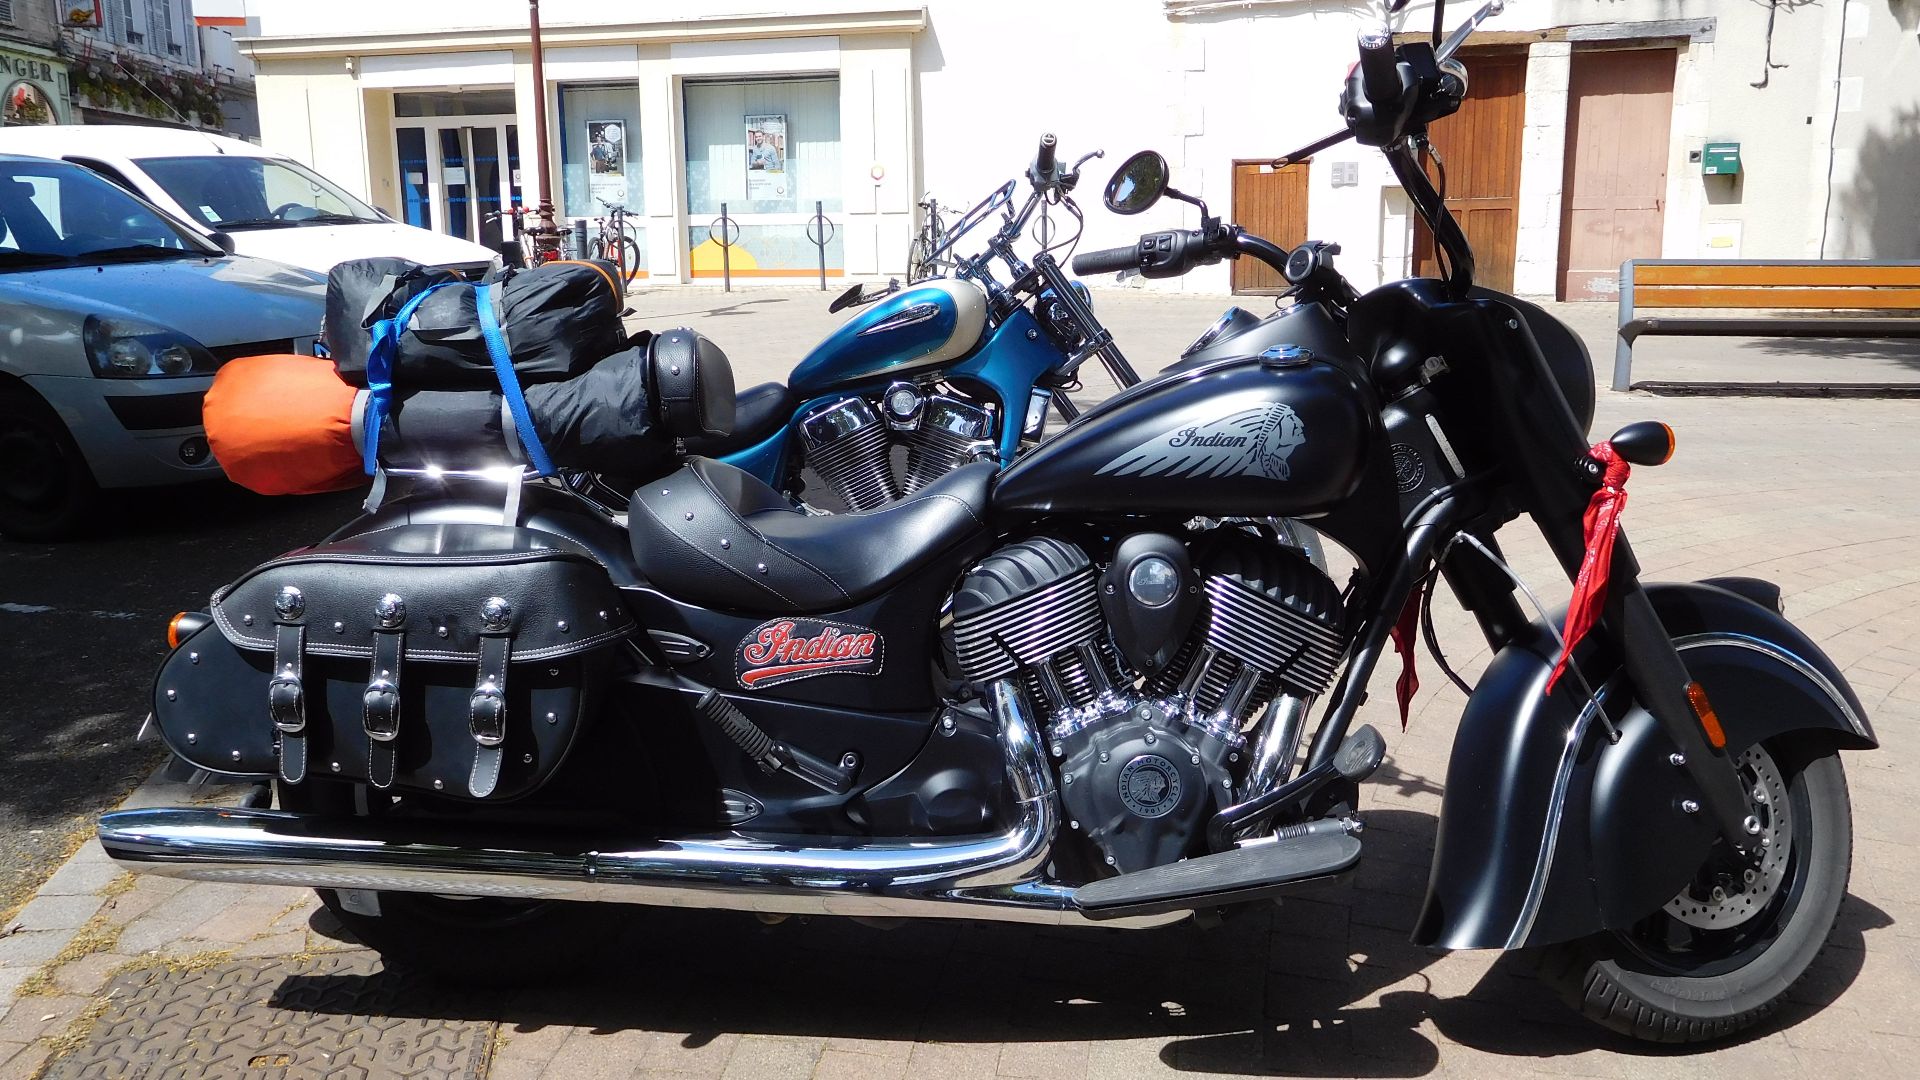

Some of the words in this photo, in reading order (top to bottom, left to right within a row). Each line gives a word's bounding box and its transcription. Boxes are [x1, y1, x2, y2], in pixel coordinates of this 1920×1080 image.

[1168, 426, 1248, 448] Indian
[744, 620, 876, 665] Indian
[1121, 765, 1135, 803] INDIAN
[1137, 757, 1179, 805] MOTORCYCLE
